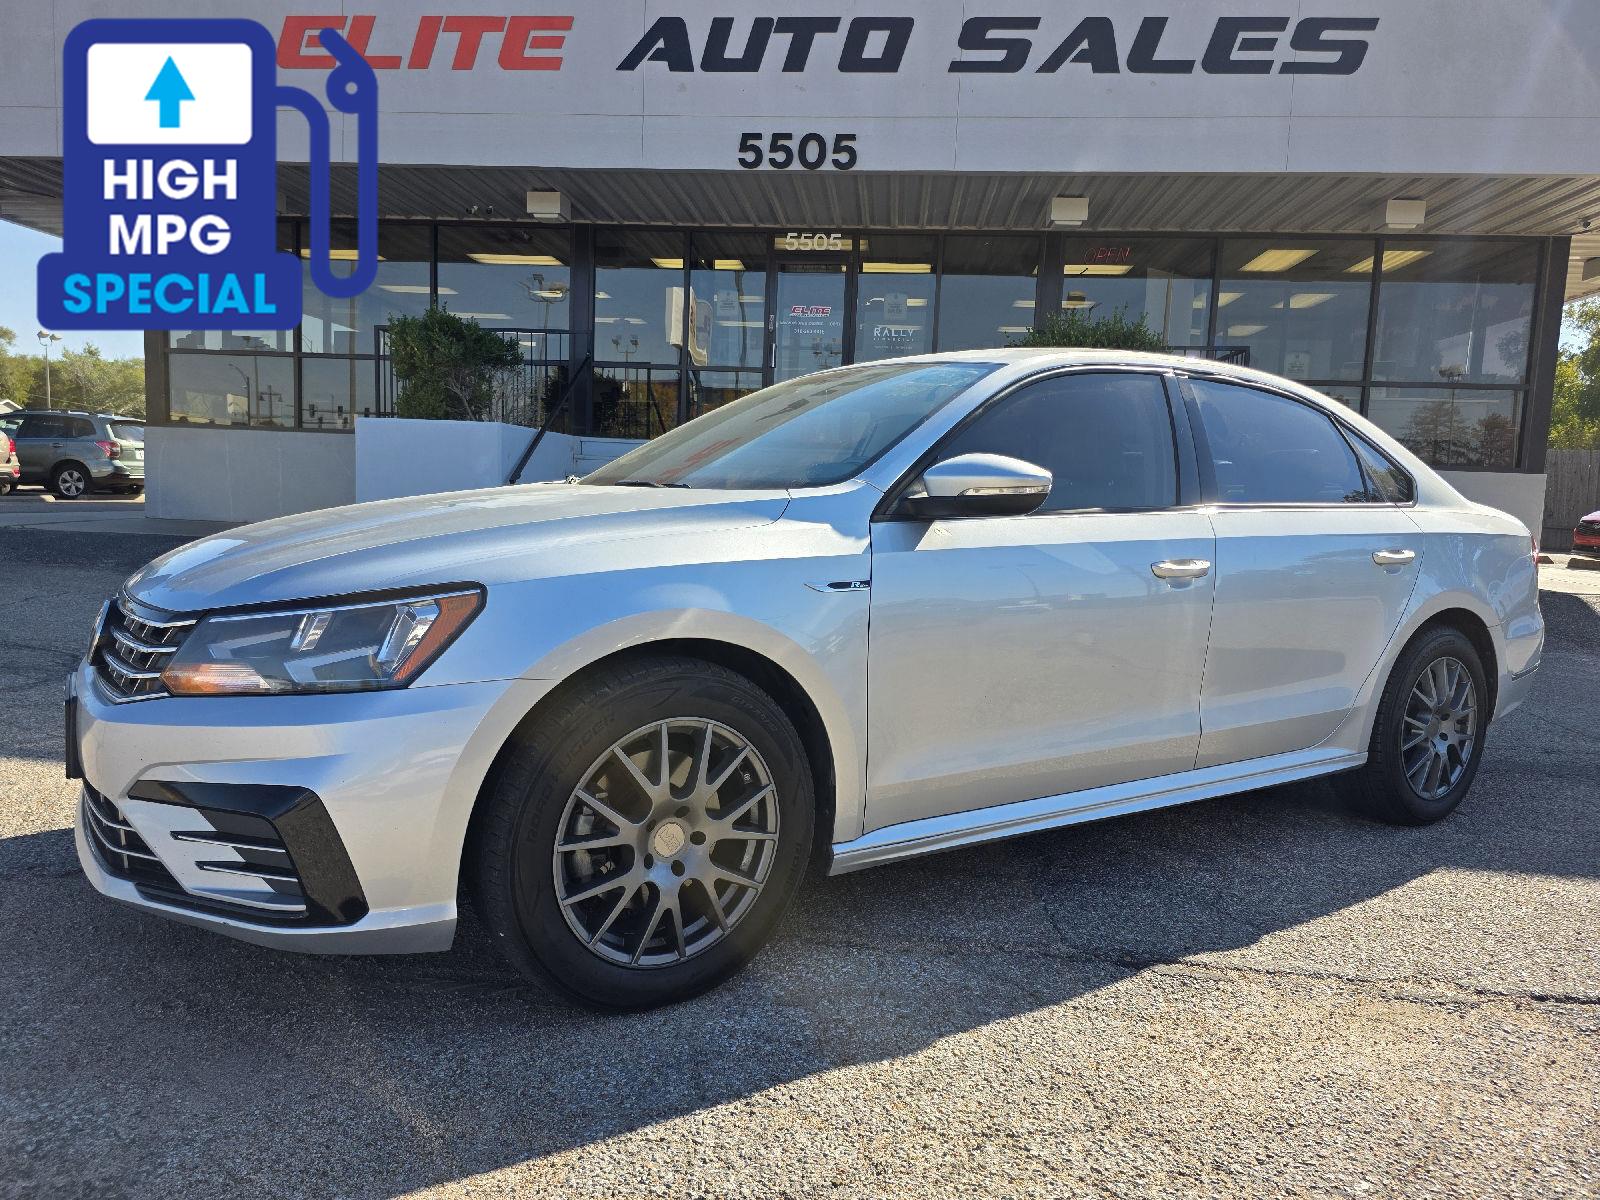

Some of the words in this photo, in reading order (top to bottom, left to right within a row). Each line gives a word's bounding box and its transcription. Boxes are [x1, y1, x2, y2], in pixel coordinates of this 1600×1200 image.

[276, 15, 574, 71] ELITE
[616, 16, 915, 73] AUTO
[948, 16, 1380, 75] SALES
[738, 132, 858, 171] 5505
[785, 233, 842, 251] 5505
[1083, 246, 1131, 263] OPEN
[791, 305, 832, 315] ELITE
[873, 326, 914, 337] RALLY
